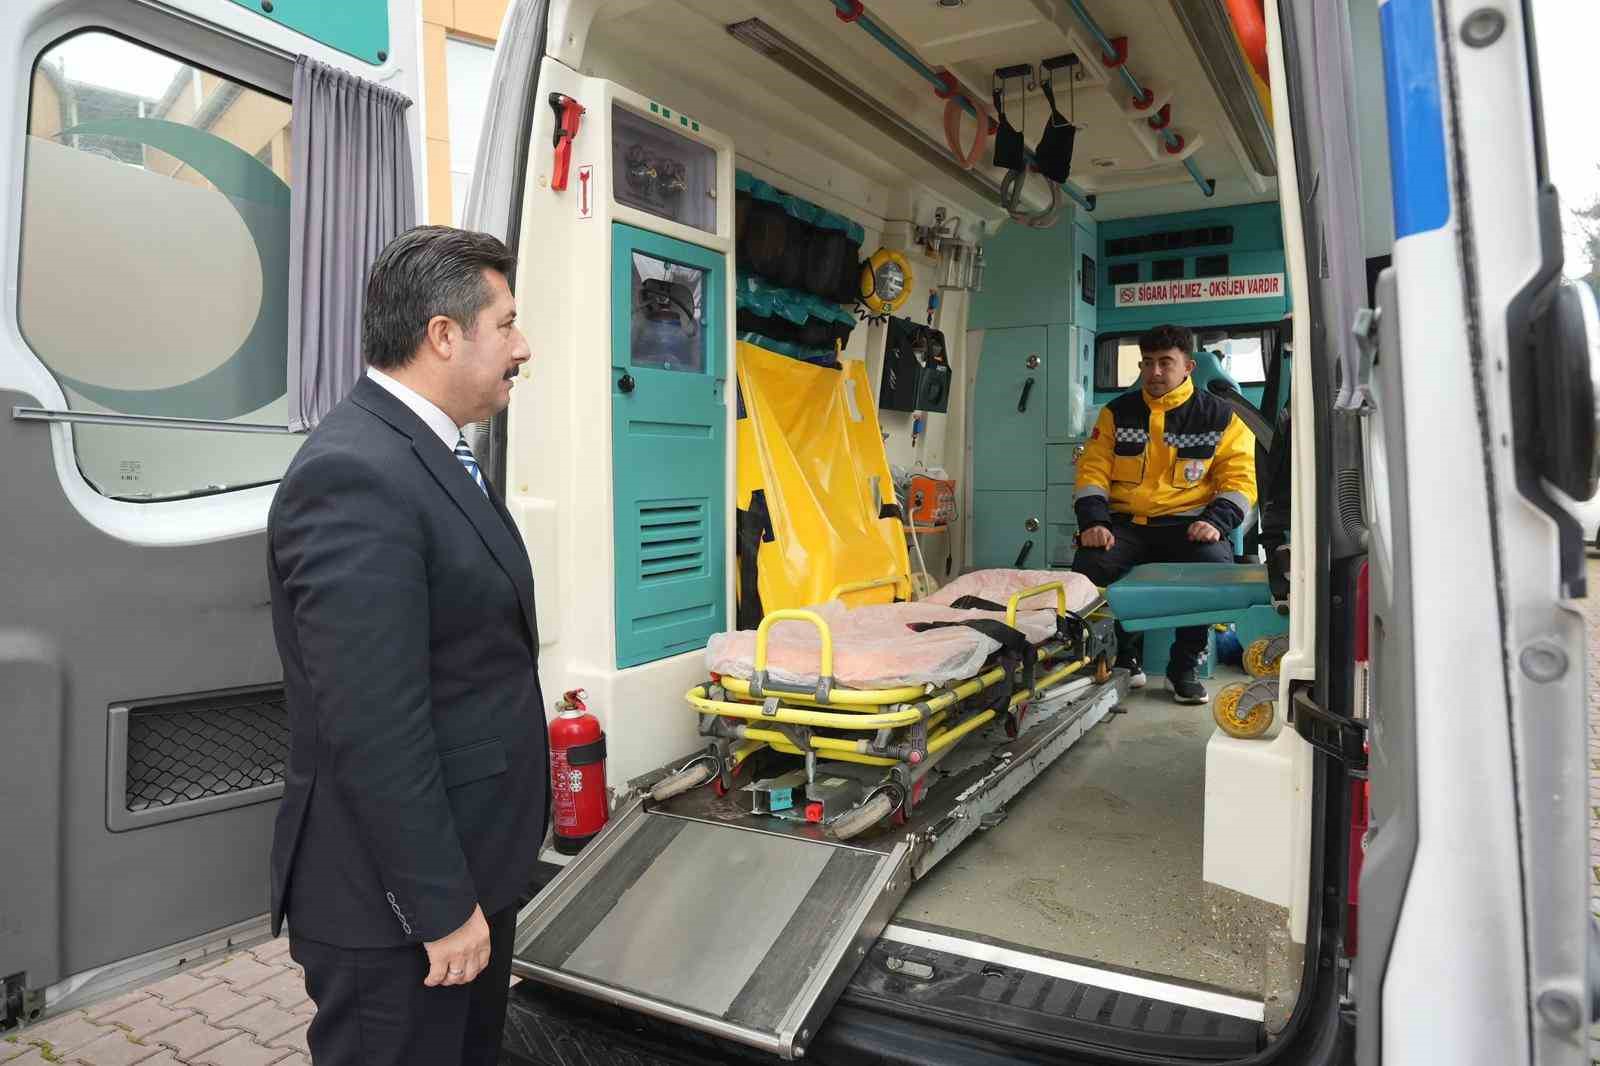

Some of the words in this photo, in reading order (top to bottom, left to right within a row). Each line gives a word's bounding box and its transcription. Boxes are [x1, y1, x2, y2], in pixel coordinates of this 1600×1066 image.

[1138, 284, 1167, 301] SİGARA
[1169, 281, 1202, 302] İÇİLMEZ
[1209, 276, 1244, 296] OKSİJEN
[1247, 277, 1278, 294] VARDIR
